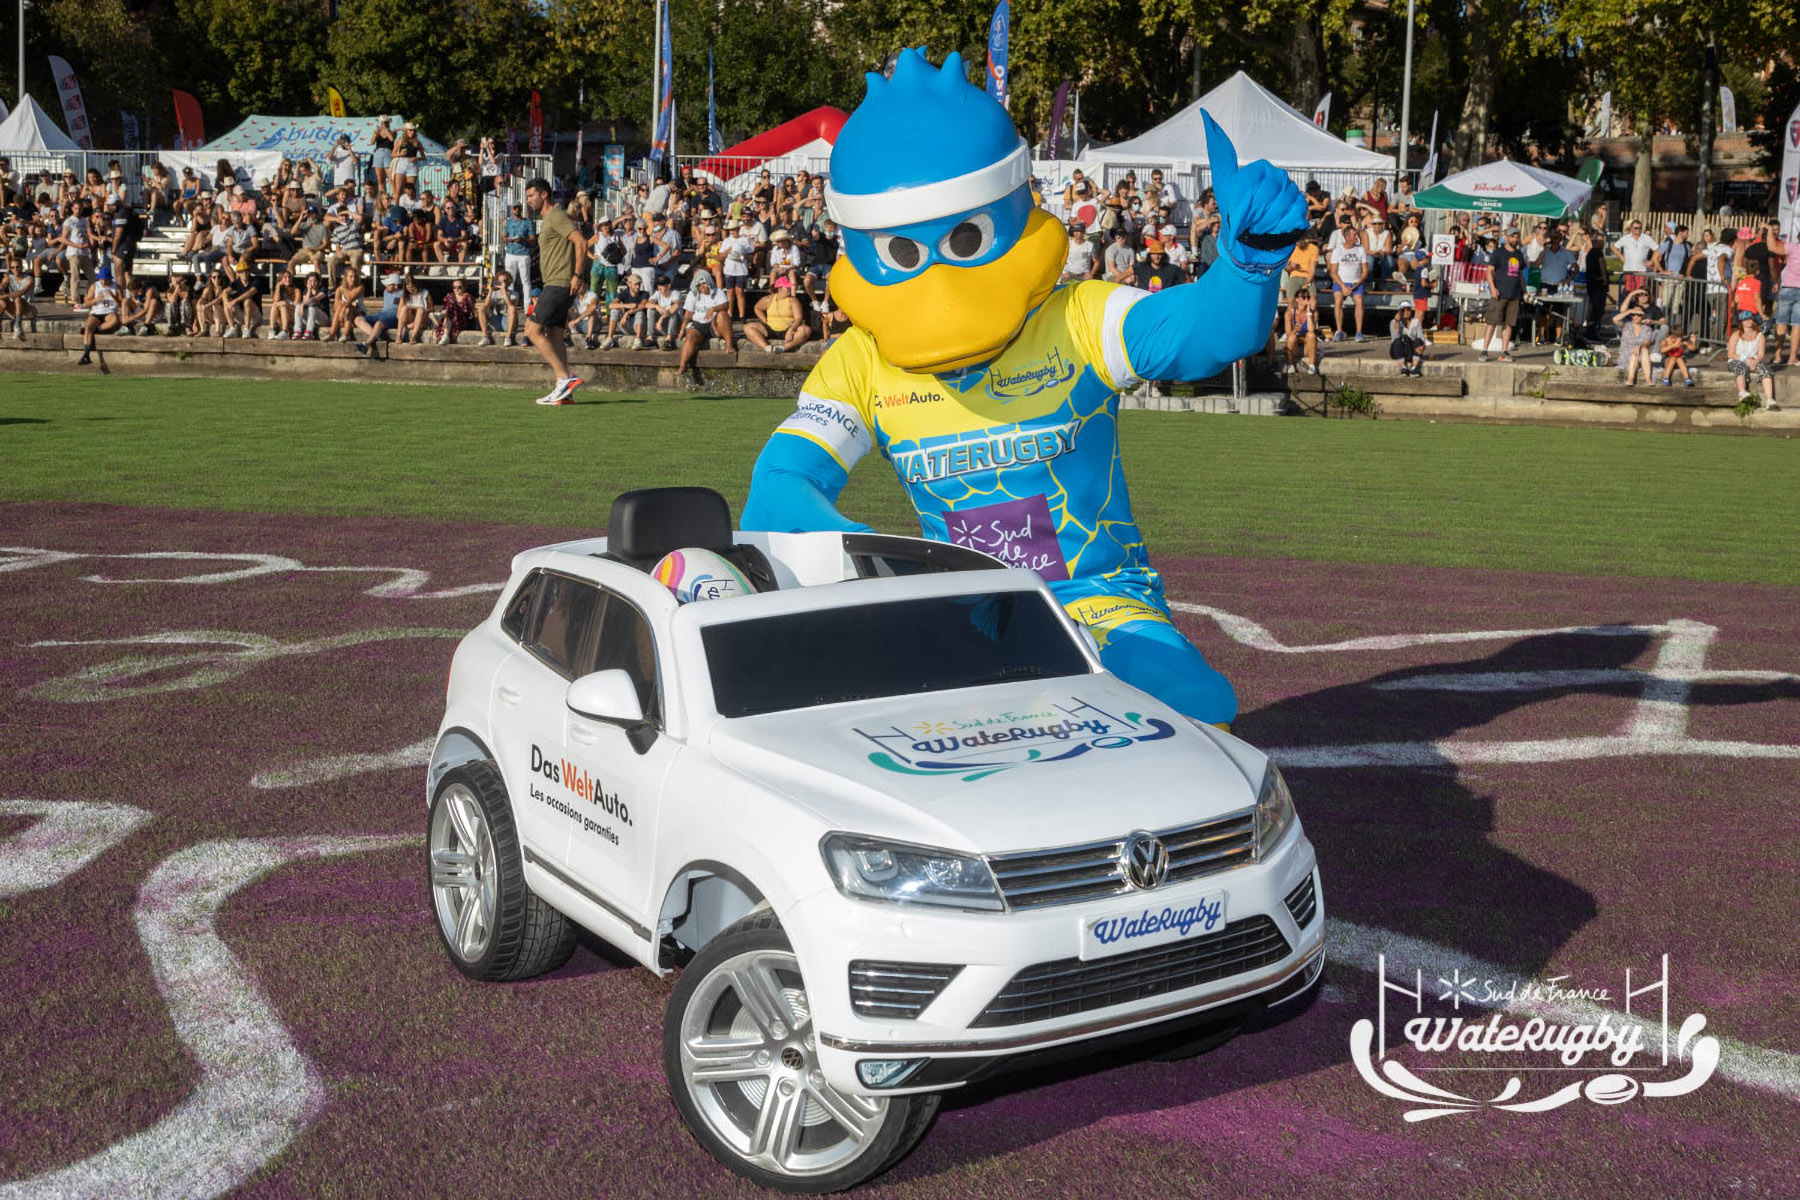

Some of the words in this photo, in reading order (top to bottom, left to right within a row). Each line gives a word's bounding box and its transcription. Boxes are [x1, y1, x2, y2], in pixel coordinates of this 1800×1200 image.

[988, 513, 1032, 547] Sud
[998, 541, 1028, 561] de
[912, 718, 1111, 754] WateRugby
[530, 743, 560, 783] Das
[530, 782, 544, 802] Les
[546, 795, 582, 824] occasions
[583, 816, 619, 846] garanties
[1094, 898, 1221, 944] WateRugby
